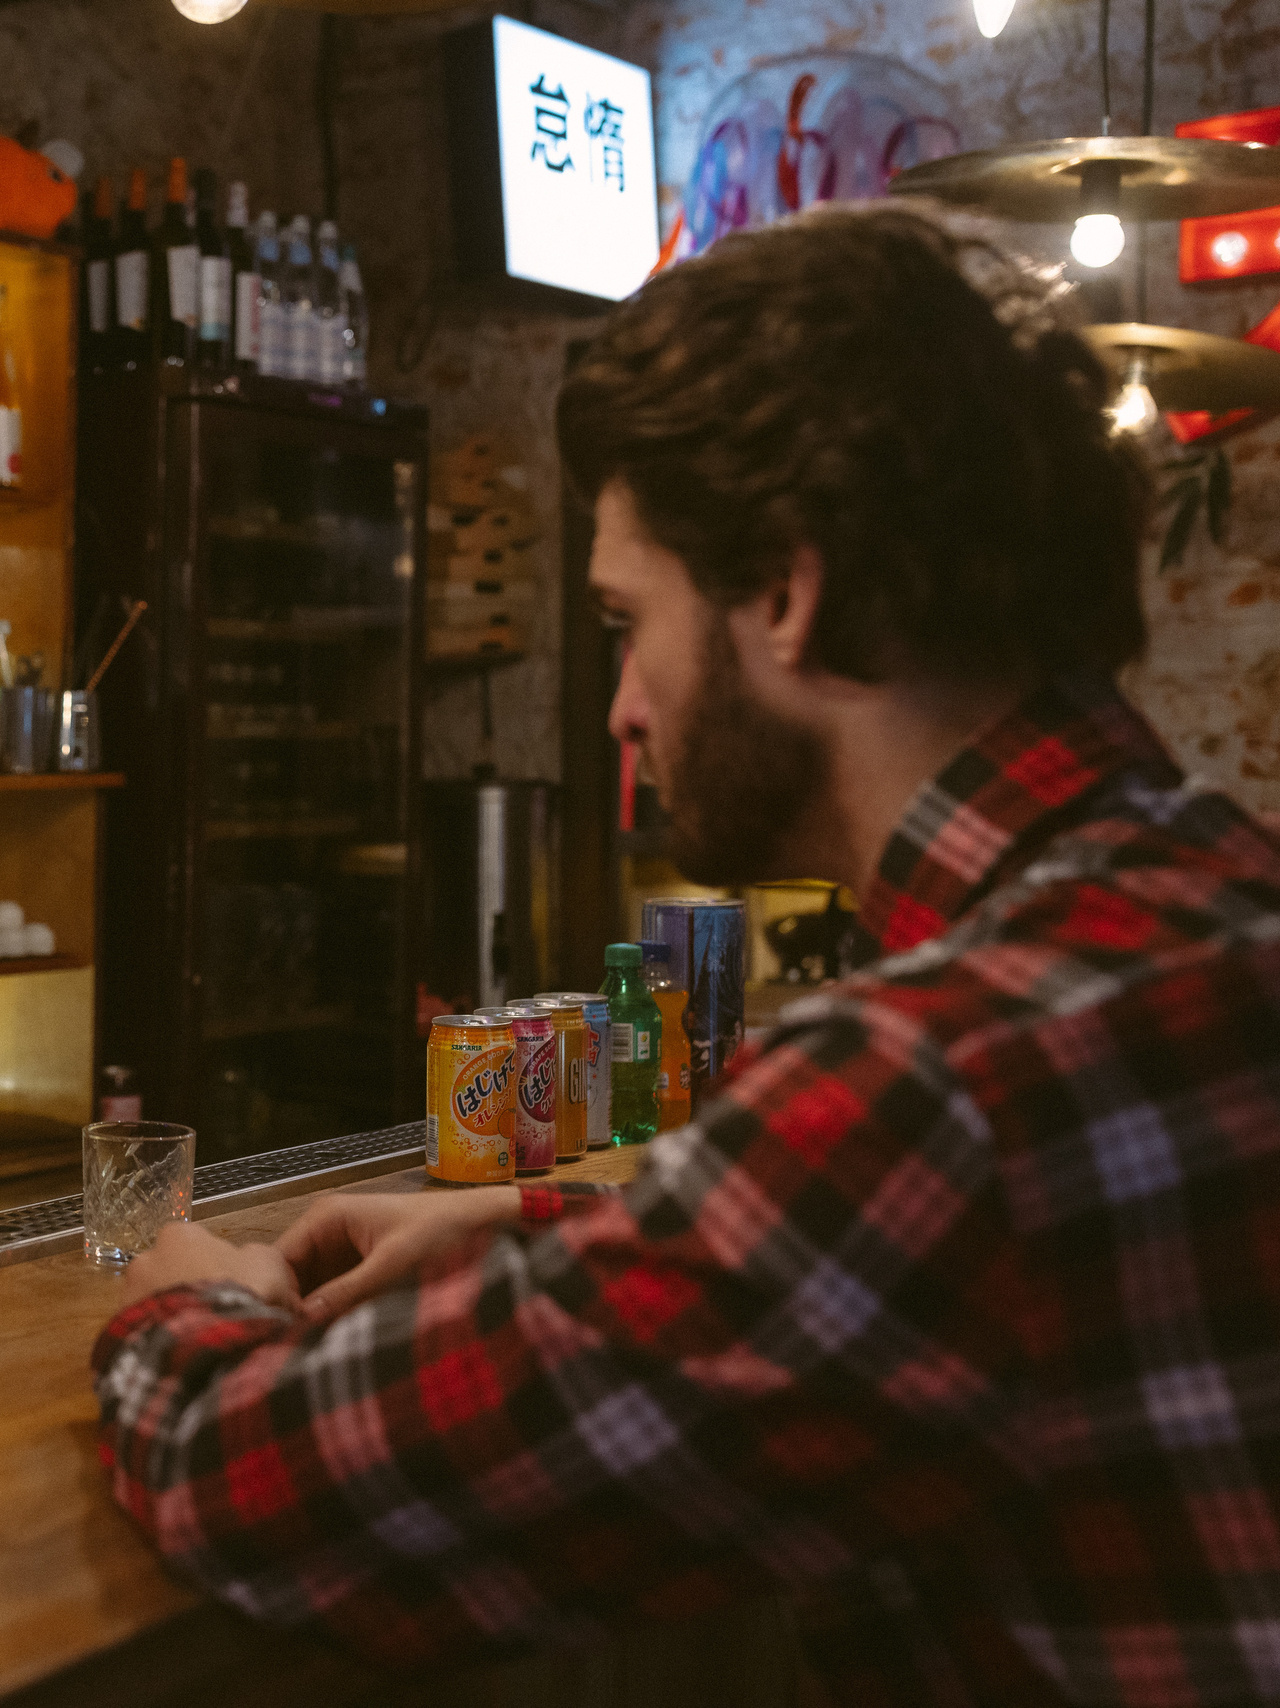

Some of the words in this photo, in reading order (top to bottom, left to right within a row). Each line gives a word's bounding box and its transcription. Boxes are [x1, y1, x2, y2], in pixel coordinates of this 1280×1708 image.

[516, 1035, 544, 1043] SANGARIA
[451, 1044, 482, 1052] SANGARIA
[463, 1057, 487, 1080] ORANGE
[487, 1050, 504, 1061] SODA
[529, 1050, 546, 1071] GRAPE
